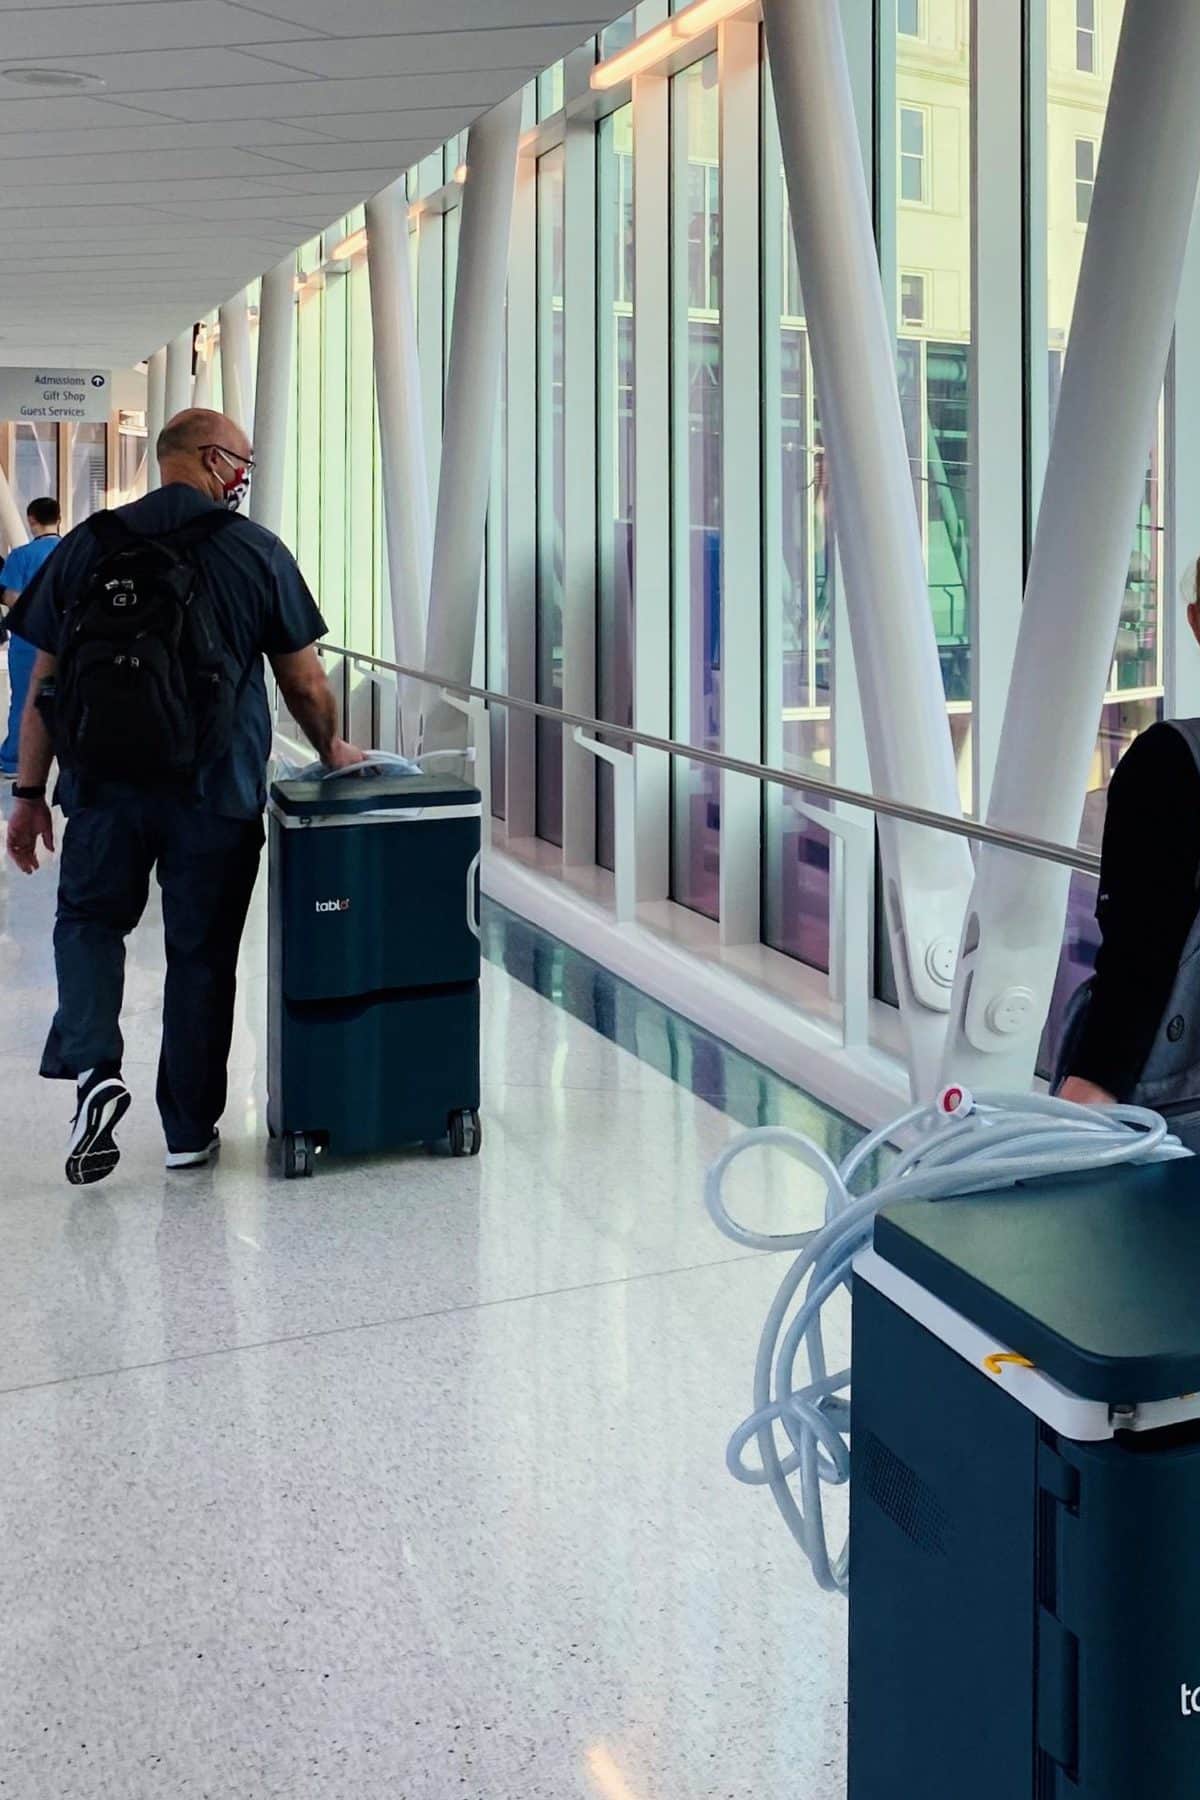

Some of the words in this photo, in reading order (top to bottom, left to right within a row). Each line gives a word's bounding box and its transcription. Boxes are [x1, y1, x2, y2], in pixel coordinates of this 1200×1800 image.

[34, 375, 86, 386] Admissions
[43, 391, 60, 401] Gift
[63, 391, 86, 403] Shop
[20, 406, 46, 417] Guest
[48, 407, 85, 417] Services
[315, 899, 350, 912] tablo
